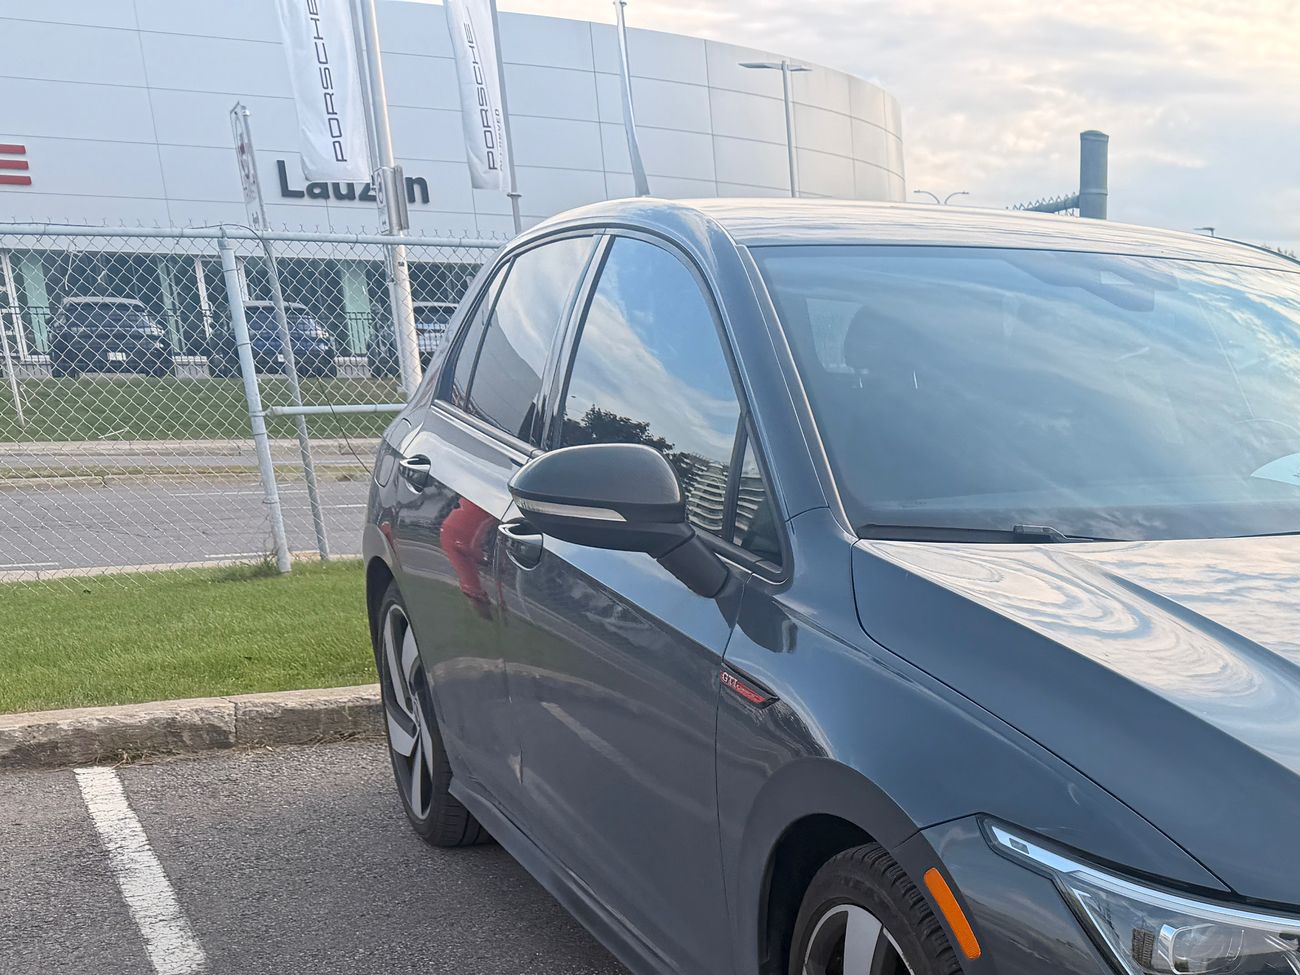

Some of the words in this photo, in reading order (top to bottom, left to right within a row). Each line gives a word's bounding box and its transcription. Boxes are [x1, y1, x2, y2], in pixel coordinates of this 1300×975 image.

[306, 0, 348, 162] PORSCHE
[463, 22, 498, 170] PORSCHE
[276, 159, 430, 204] Lauzn
[722, 672, 738, 689] GTI
